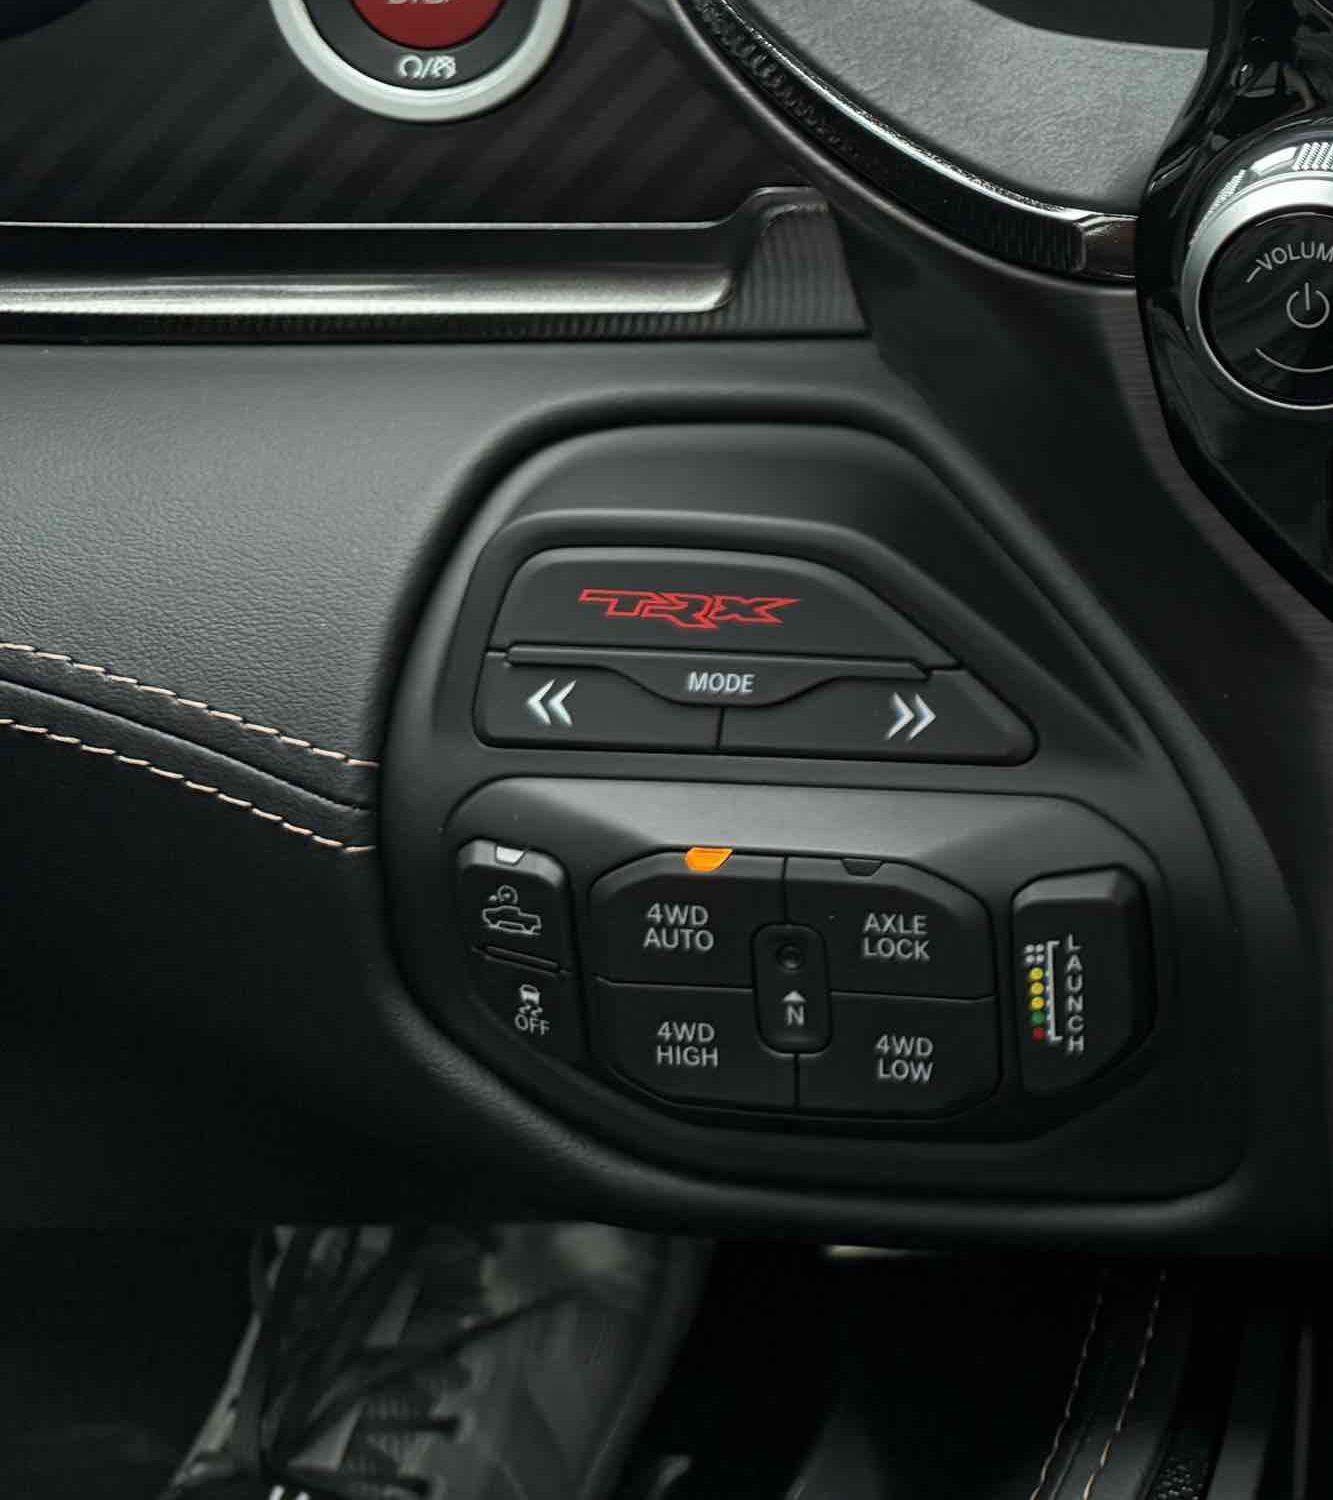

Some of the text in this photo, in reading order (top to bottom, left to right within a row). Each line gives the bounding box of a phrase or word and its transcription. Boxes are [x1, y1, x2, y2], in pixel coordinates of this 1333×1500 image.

[579, 589, 800, 629] TRX
[687, 671, 755, 694] MODE
[647, 904, 709, 927] 4WD
[864, 913, 929, 936] AXLE
[642, 927, 714, 952] AUTO
[862, 937, 930, 961] LOCK
[514, 1012, 550, 1036] OFF
[786, 1004, 804, 1027] N
[657, 1021, 714, 1044] 4WD
[656, 1044, 719, 1068] HIGH
[876, 1035, 933, 1058] 4WD
[877, 1058, 933, 1082] LOW
